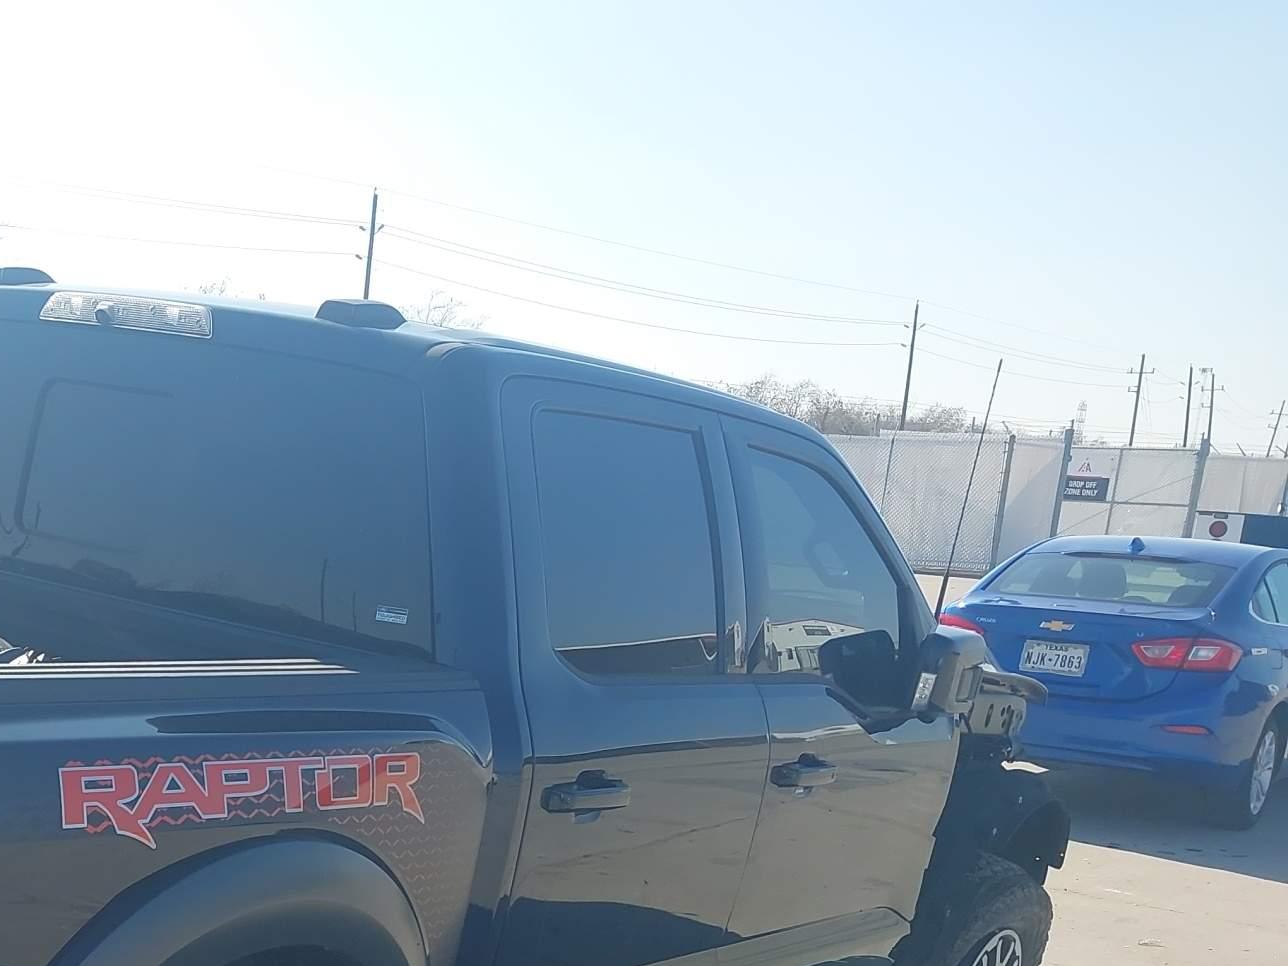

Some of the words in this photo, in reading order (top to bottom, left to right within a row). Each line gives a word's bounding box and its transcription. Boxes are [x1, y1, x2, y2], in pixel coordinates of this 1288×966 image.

[1068, 480, 1085, 488] DROP
[1085, 481, 1097, 489] OFF
[1064, 487, 1081, 496] ZONE
[1081, 489, 1098, 497] ONLY
[58, 752, 425, 849] RAPTOR
